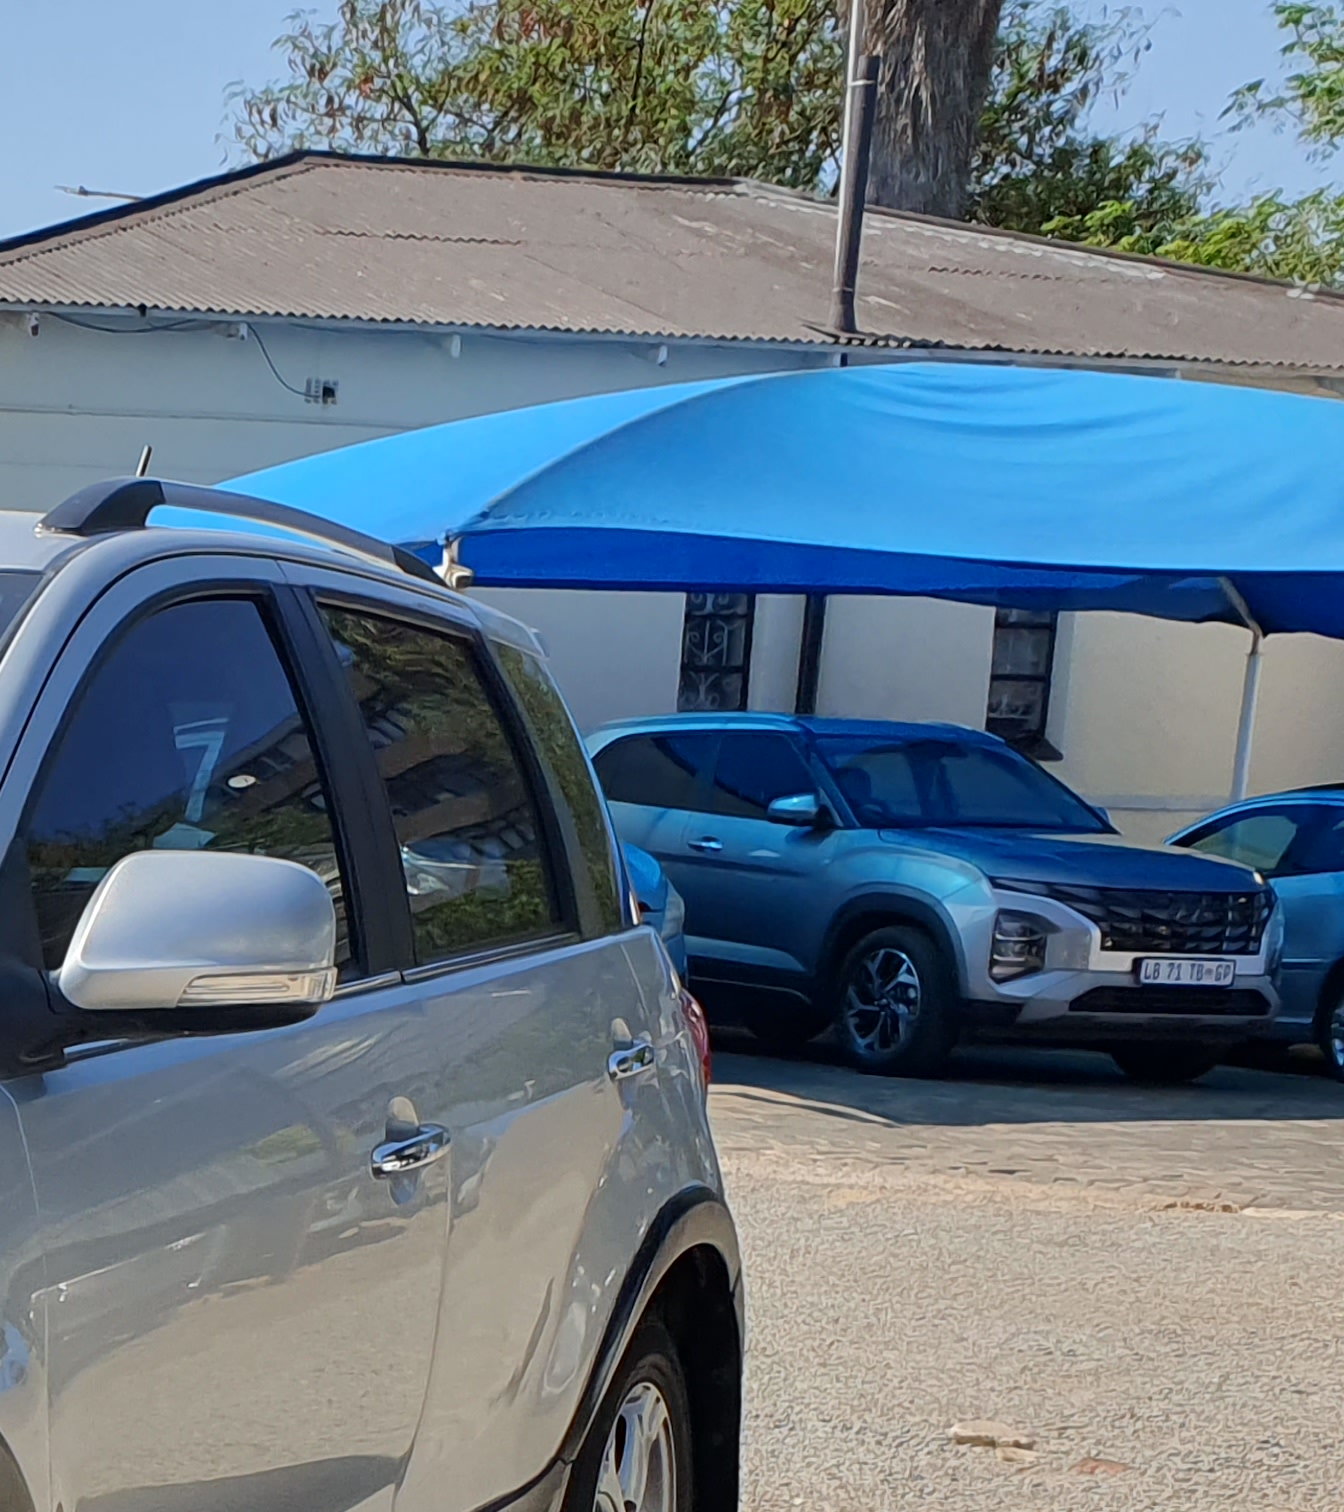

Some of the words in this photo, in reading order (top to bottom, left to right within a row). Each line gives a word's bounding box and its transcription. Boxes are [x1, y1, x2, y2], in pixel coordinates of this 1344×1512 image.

[1144, 962, 1161, 980] LB
[1167, 962, 1182, 981] 71
[1214, 964, 1231, 982] GP
